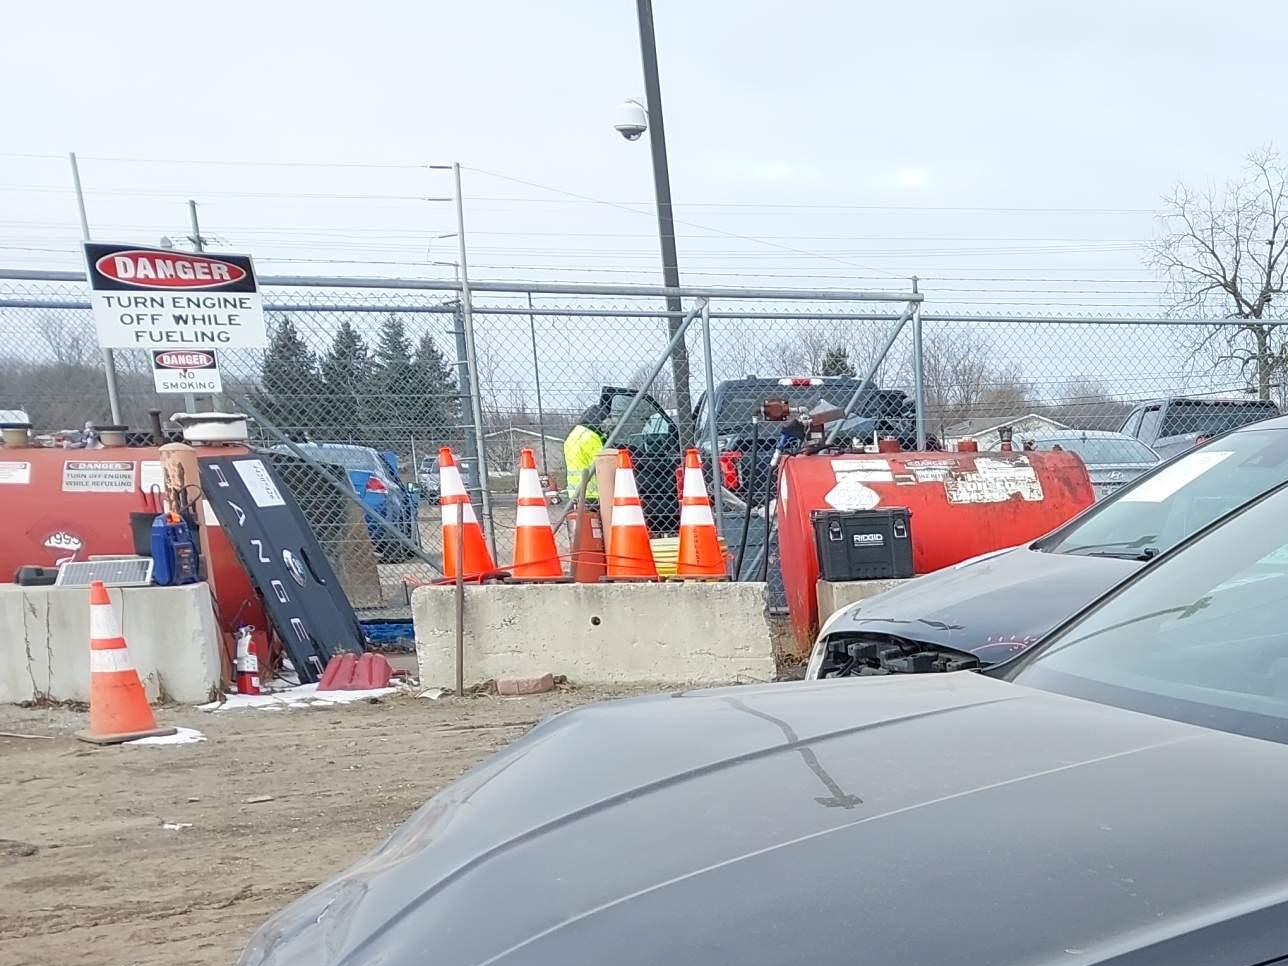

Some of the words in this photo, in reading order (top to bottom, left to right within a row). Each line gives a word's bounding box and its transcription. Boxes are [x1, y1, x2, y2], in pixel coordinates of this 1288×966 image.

[114, 256, 231, 281] DANGER
[102, 296, 165, 309] TURN
[172, 297, 253, 310] ENGINE
[119, 313, 163, 326] OFF
[171, 314, 242, 327] WHILE
[134, 330, 231, 344] FUELING
[162, 354, 207, 365] DANGER
[179, 371, 195, 380] NO
[162, 381, 216, 390] SMOKING
[77, 462, 122, 471] DANGER
[853, 533, 884, 543] RIDGID
